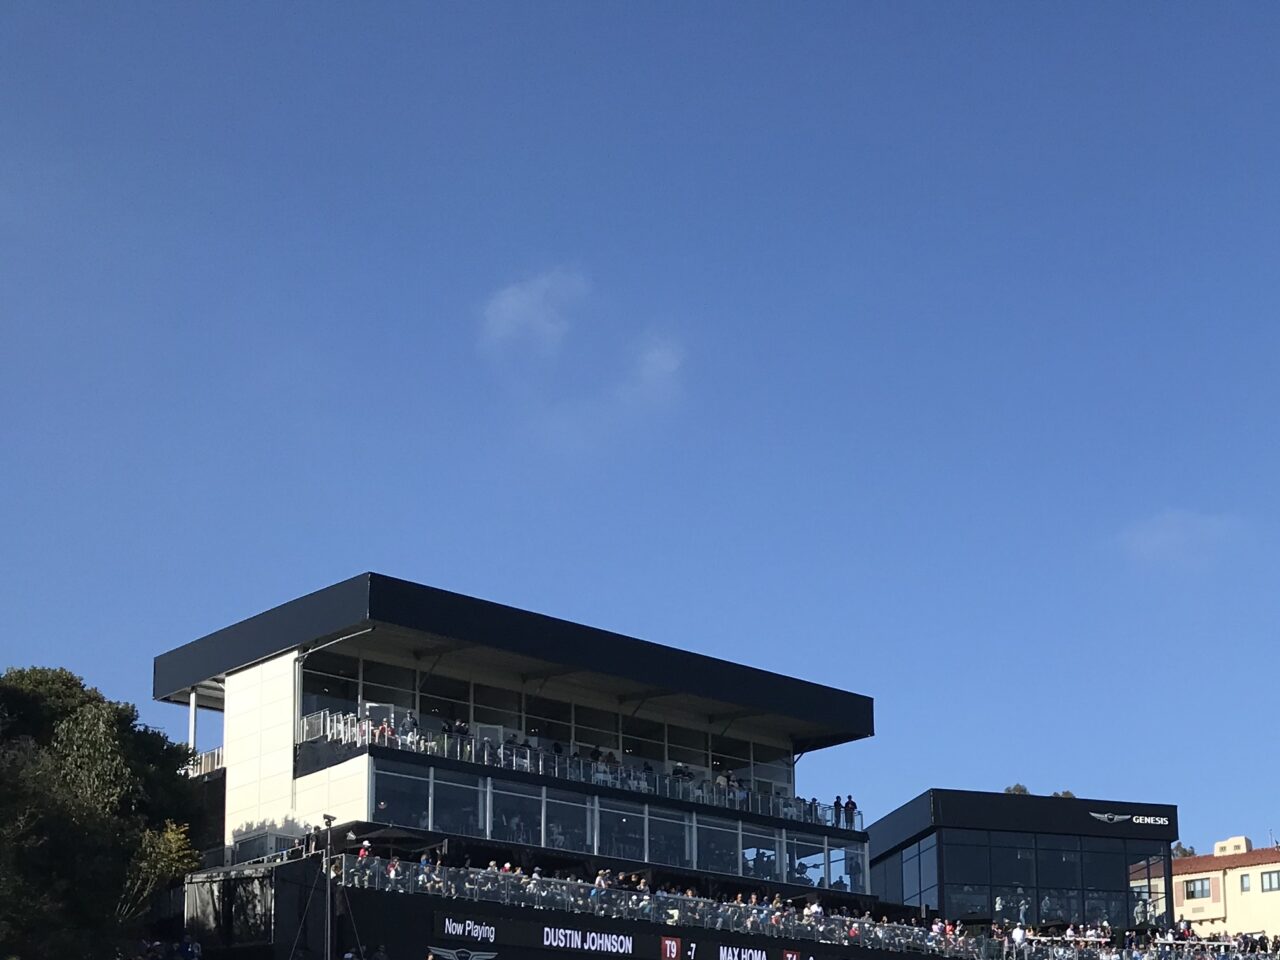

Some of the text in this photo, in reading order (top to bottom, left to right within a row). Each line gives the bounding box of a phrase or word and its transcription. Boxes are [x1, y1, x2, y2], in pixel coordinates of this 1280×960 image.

[1132, 815, 1169, 825] GENESIS
[444, 917, 496, 943] Now Playing
[543, 927, 696, 960] DUSTIN JOHNSON T9 -7
